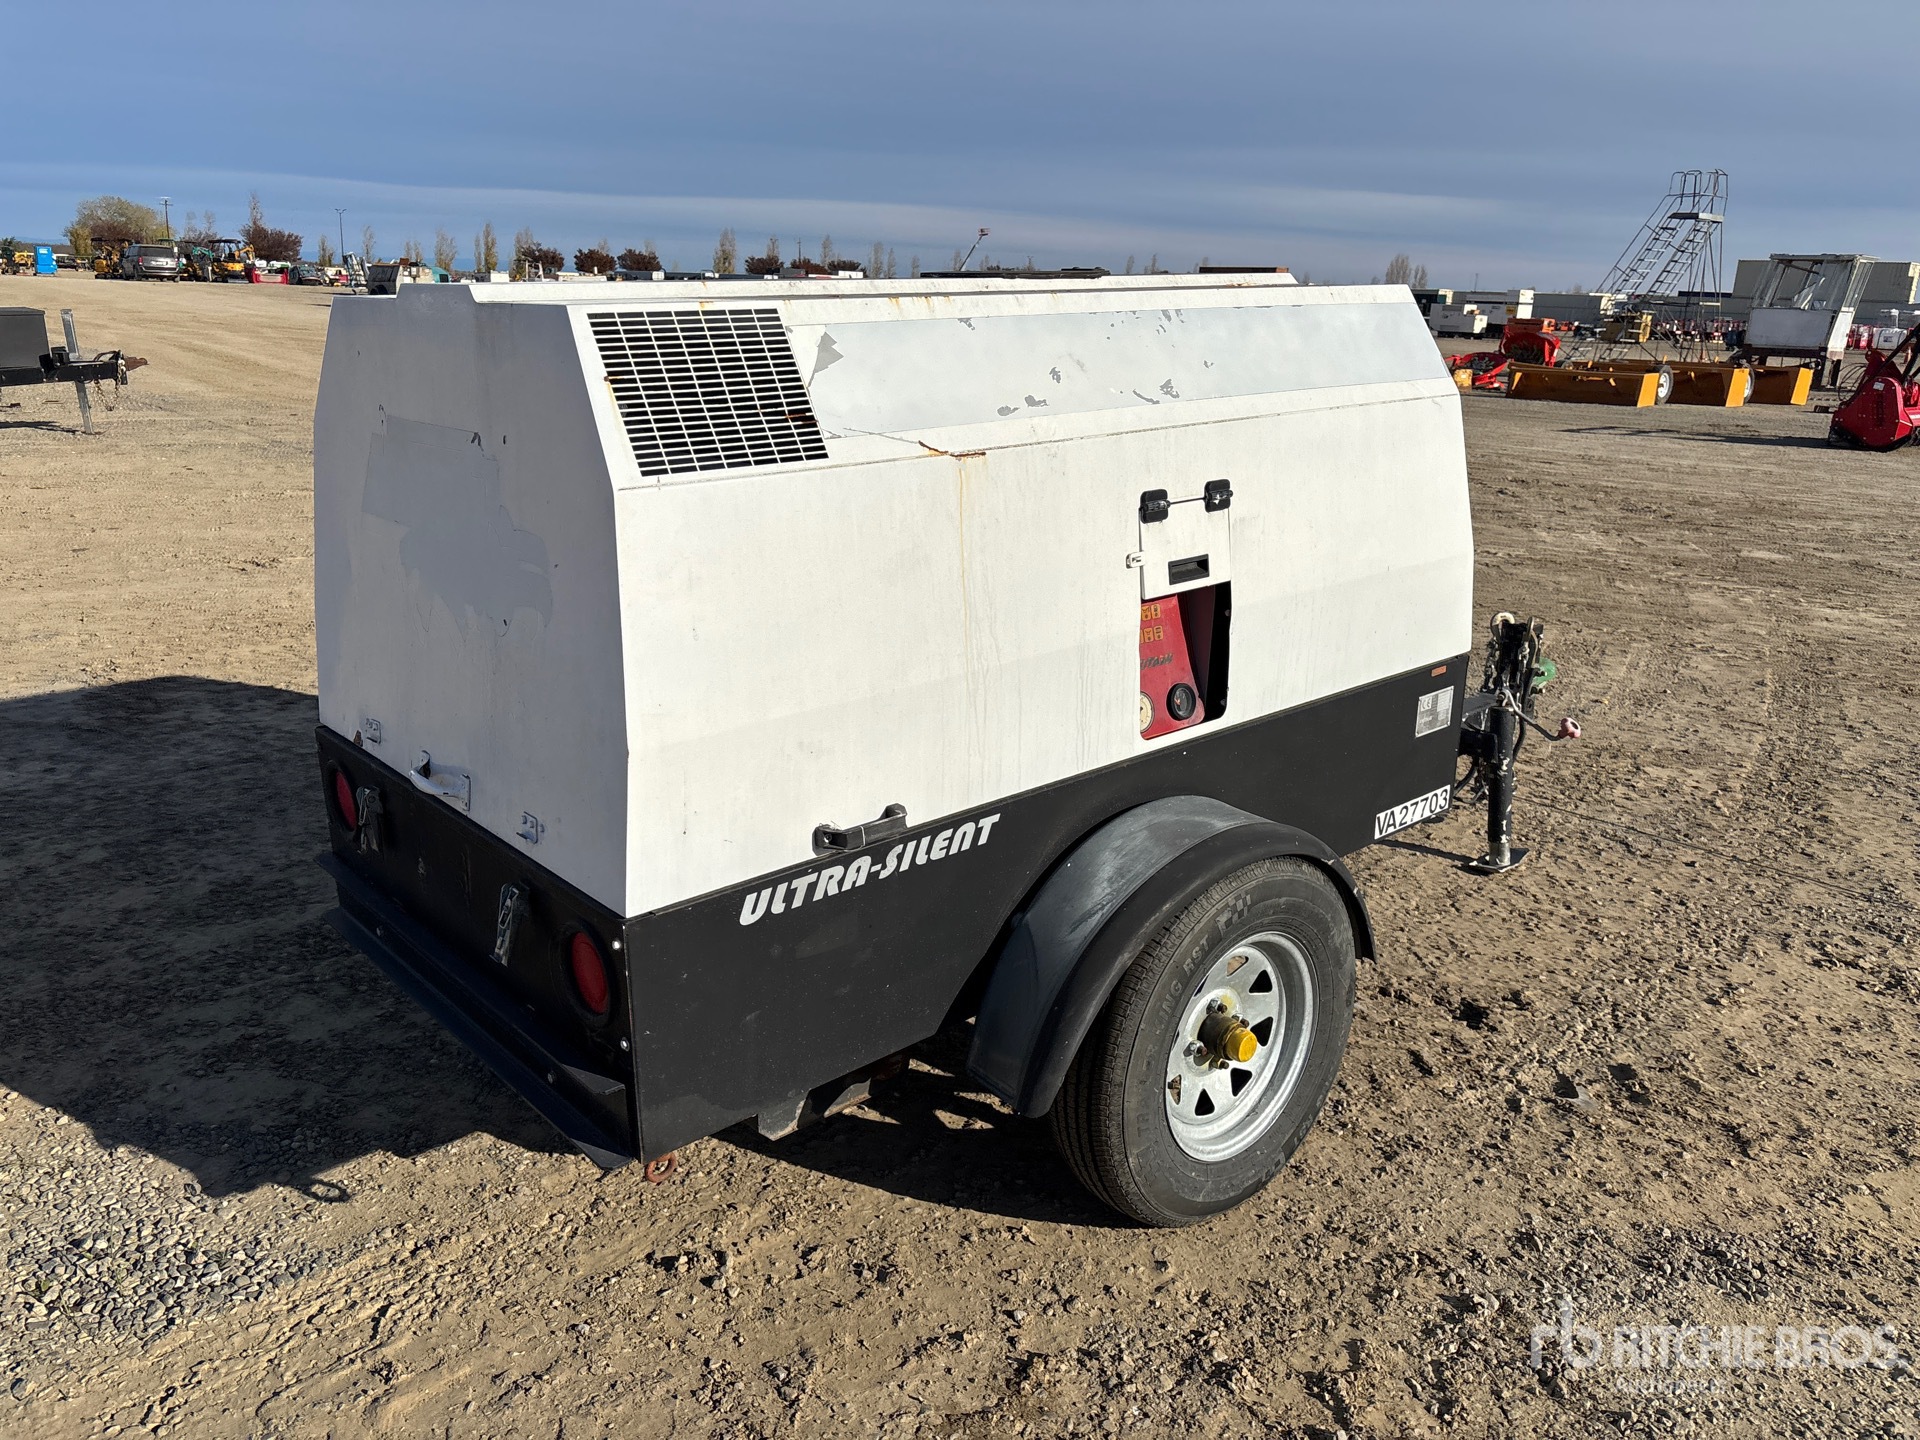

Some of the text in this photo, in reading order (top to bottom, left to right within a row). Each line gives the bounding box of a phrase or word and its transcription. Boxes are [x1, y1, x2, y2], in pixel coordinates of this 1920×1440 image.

[1376, 788, 1449, 836] VA27703
[739, 813, 1001, 926] ULTRA-SILENT
[1136, 1044, 1158, 1138] TRAER
[1183, 934, 1211, 977] RST
